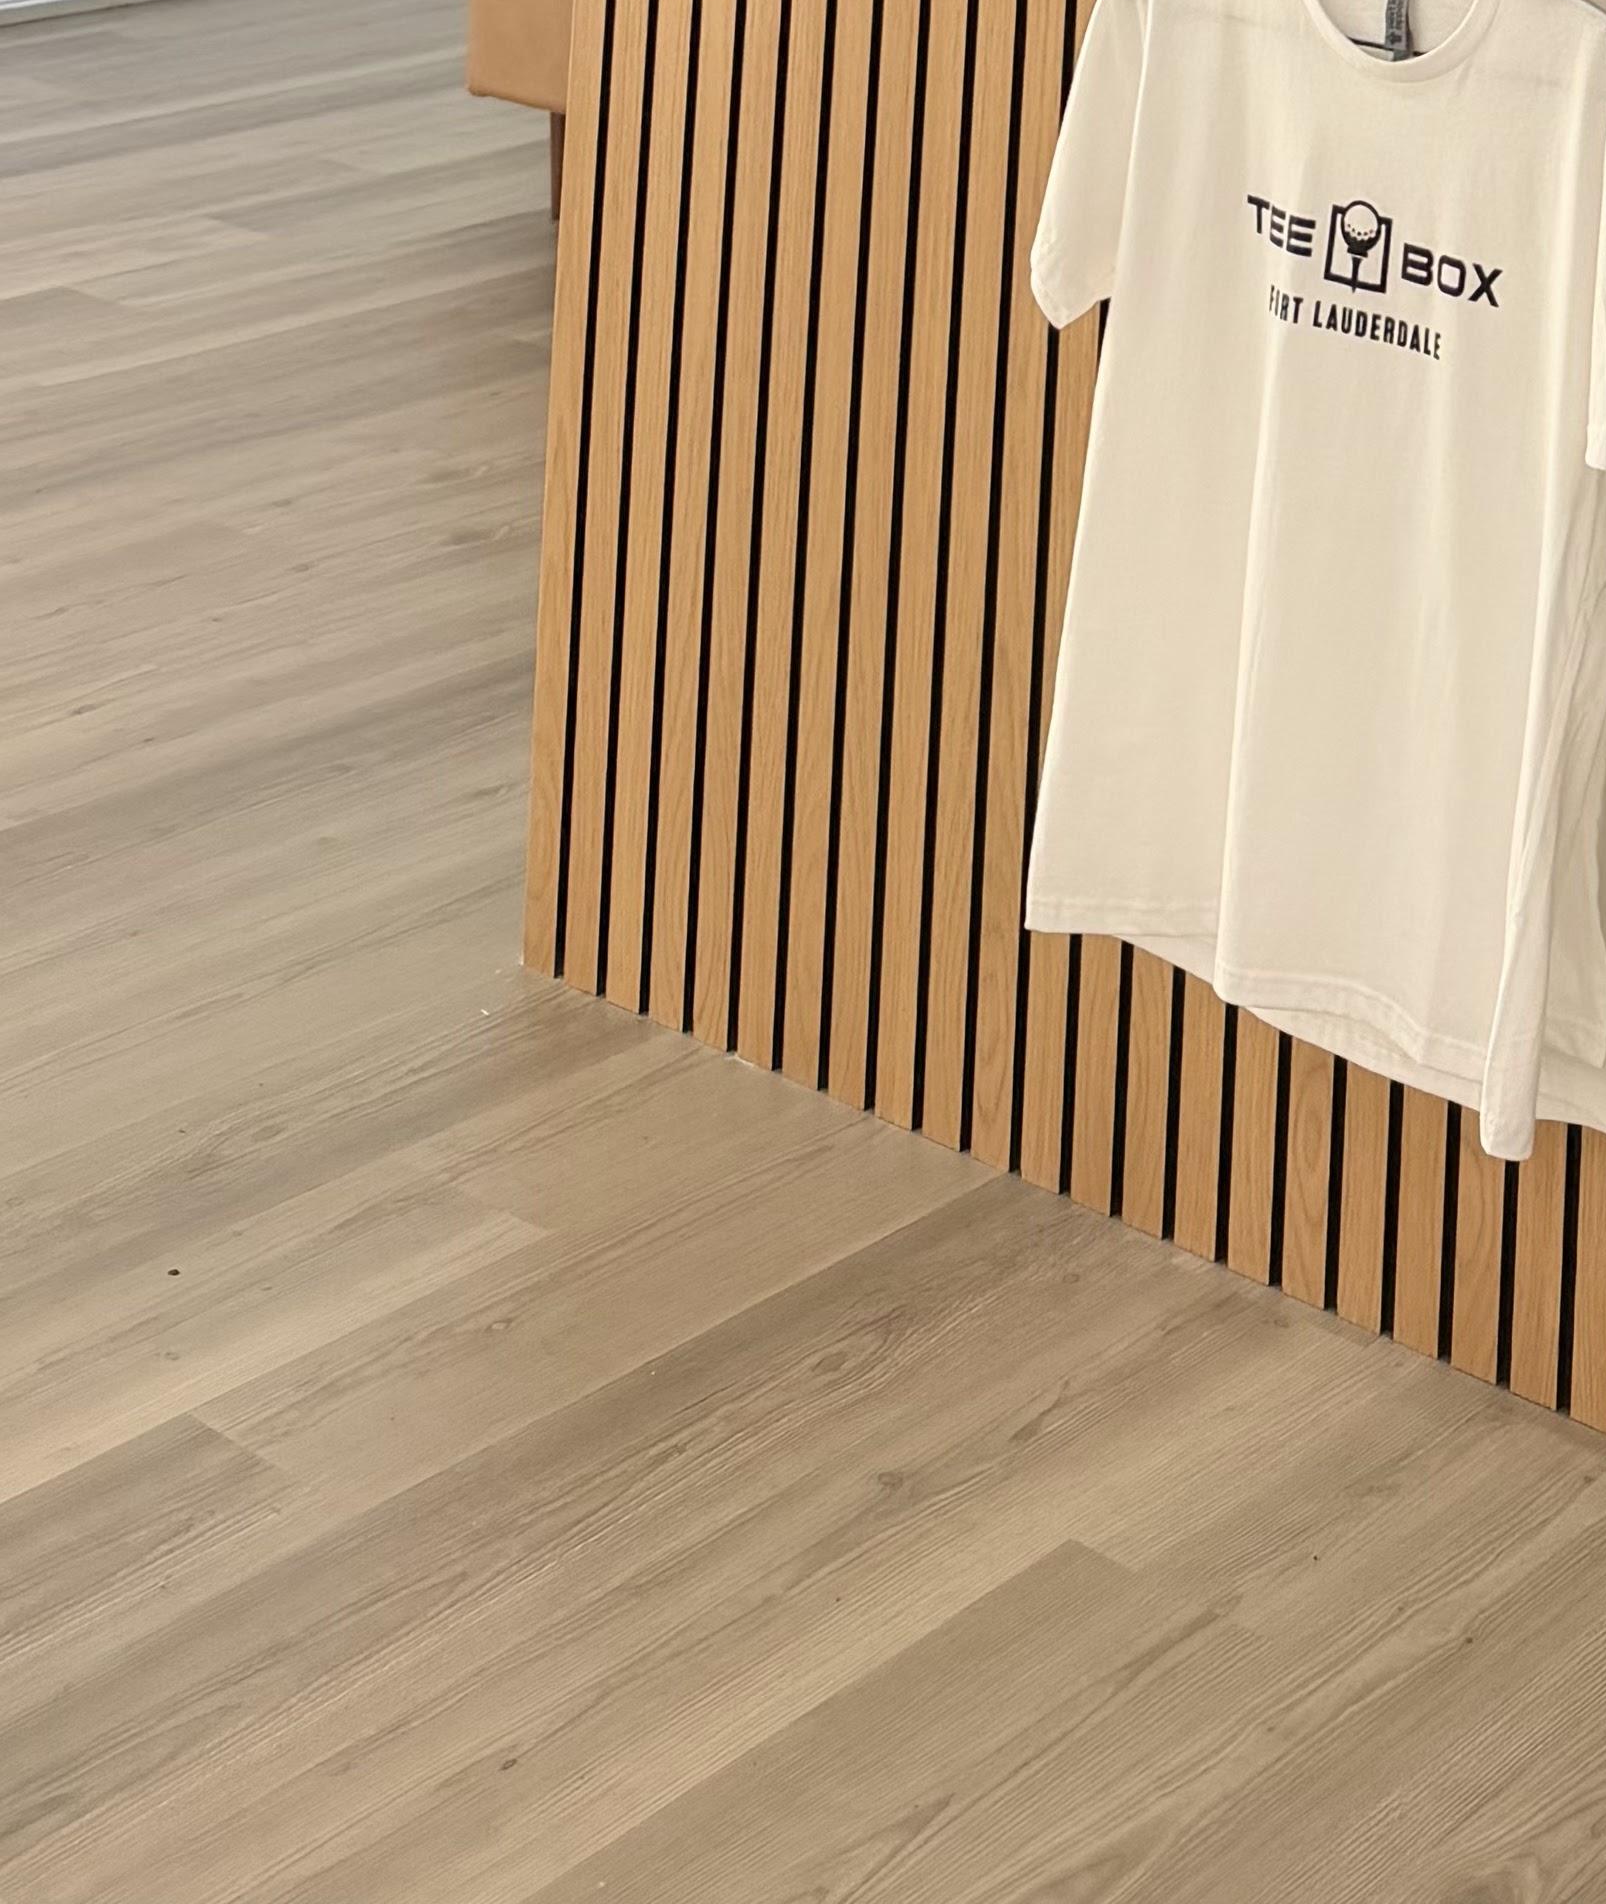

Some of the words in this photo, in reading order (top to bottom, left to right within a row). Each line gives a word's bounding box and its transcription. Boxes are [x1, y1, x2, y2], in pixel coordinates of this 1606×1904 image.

[1247, 194, 1316, 258] TEE
[1401, 242, 1504, 308] BOX
[1312, 299, 1442, 361] LAUDERDALE
